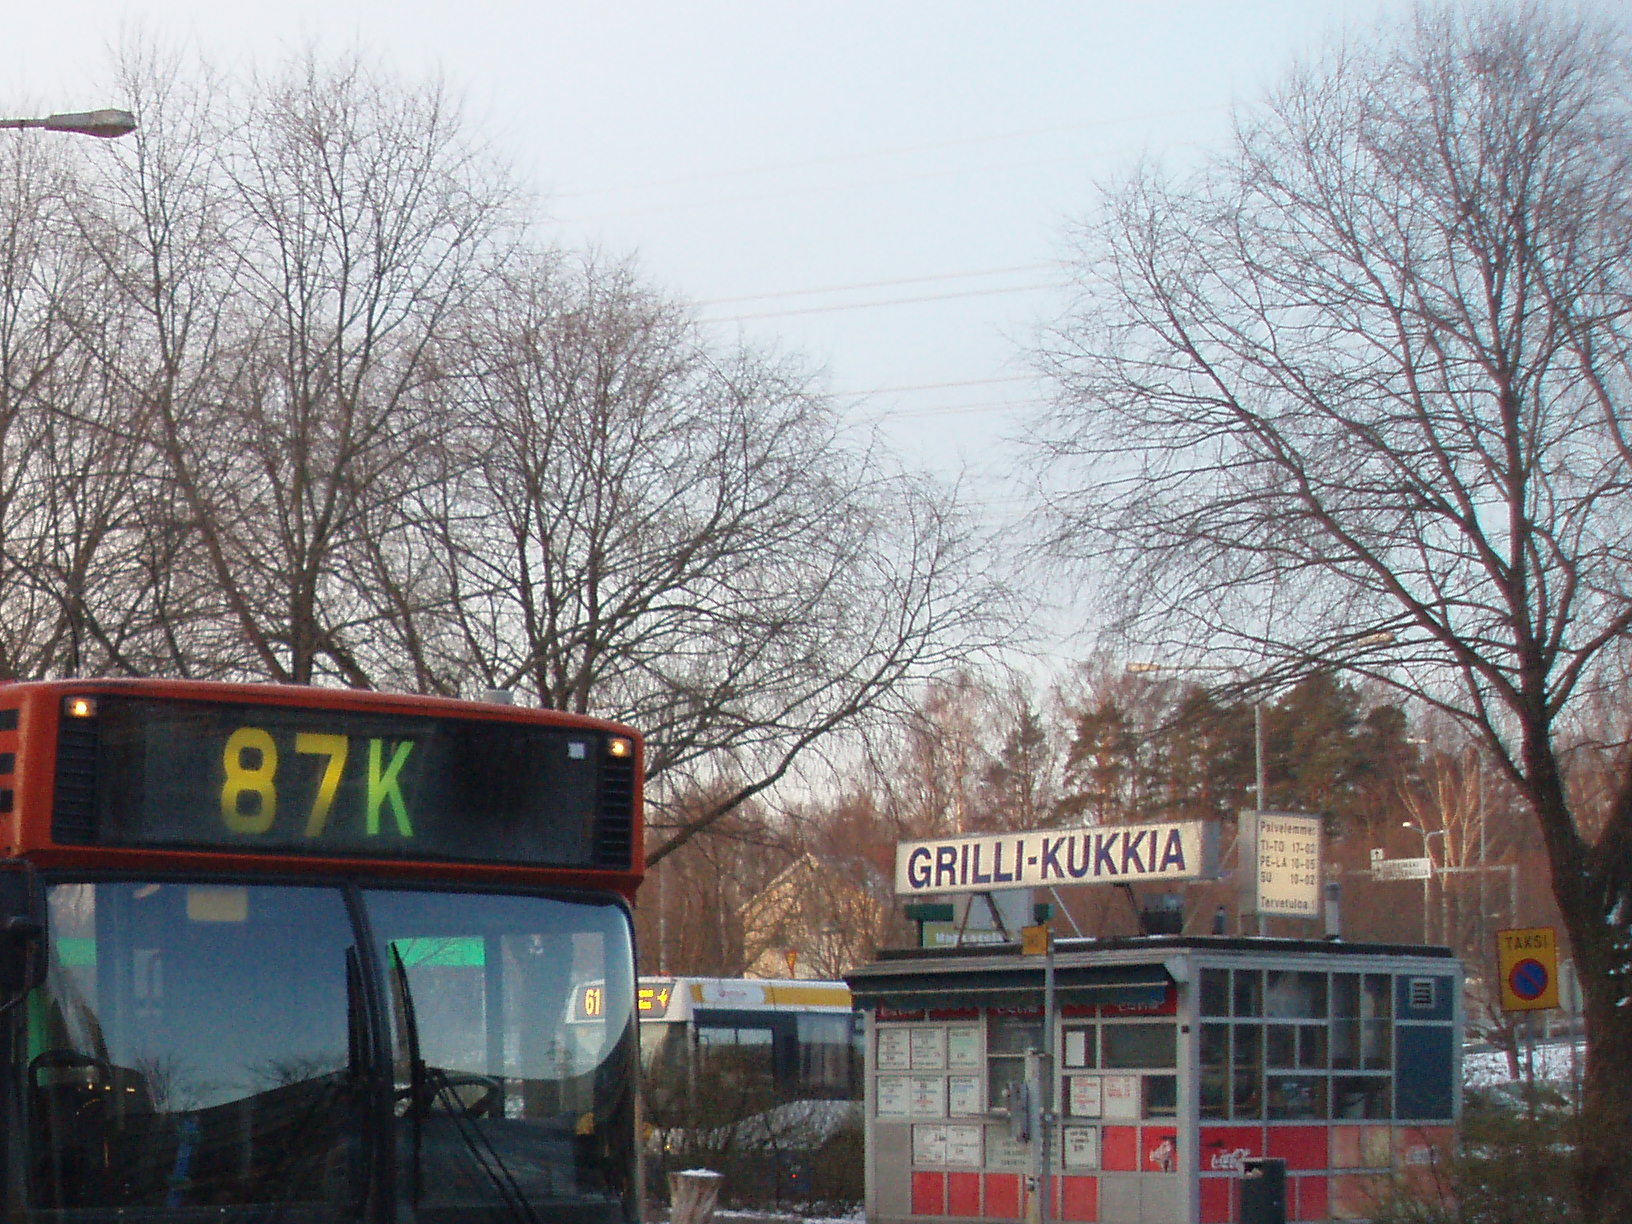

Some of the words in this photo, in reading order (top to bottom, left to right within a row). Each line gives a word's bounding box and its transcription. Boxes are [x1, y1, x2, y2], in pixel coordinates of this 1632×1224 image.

[908, 828, 1187, 889] GRILLI-KUKKIA
[1504, 935, 1549, 951] TAKSI
[585, 988, 601, 1016] 61
